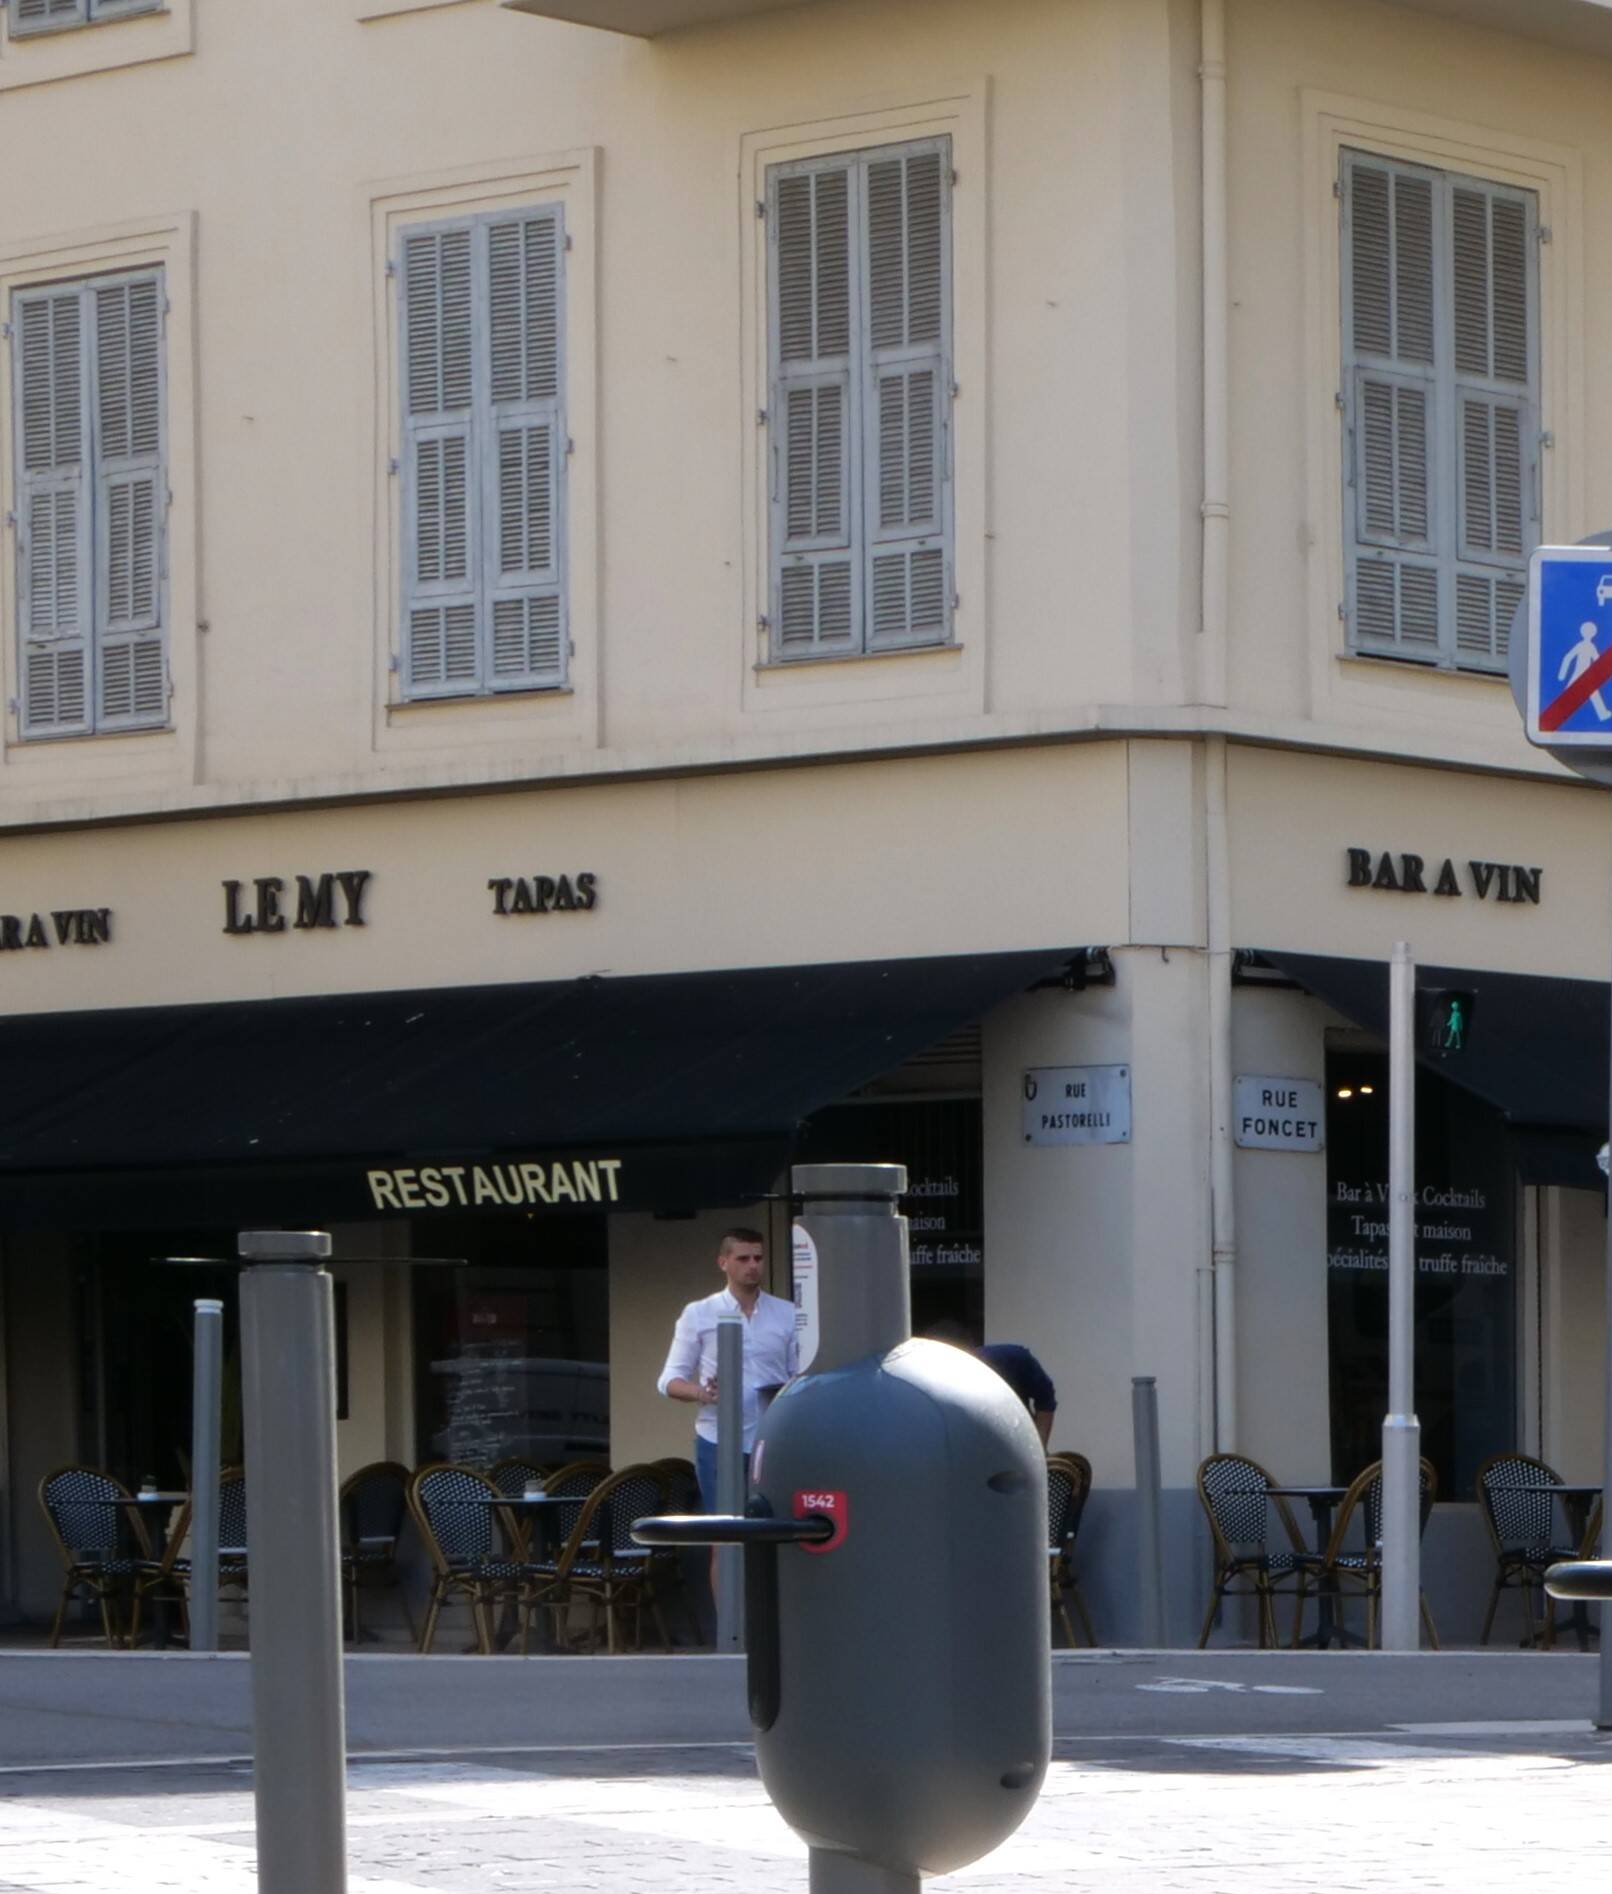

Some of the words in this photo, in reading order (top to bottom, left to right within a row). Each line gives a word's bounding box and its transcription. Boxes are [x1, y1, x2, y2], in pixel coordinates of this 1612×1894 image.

[1347, 847, 1427, 893] BAR
[1433, 857, 1462, 897] A
[1469, 860, 1543, 906] VIN
[221, 877, 286, 935] LE
[293, 870, 373, 929] MY
[487, 871, 599, 915] TAPAS
[25, 911, 49, 948] A
[50, 908, 112, 946] VIN
[1065, 1082, 1086, 1099] RUE
[1262, 1089, 1298, 1108] RUE
[1041, 1112, 1111, 1129] PASTORELLI
[1242, 1116, 1318, 1139] FONCET
[366, 1160, 622, 1210] RESTAURANT
[1336, 1181, 1361, 1201] Bar
[1423, 1185, 1486, 1208] Cocktails
[1423, 1221, 1472, 1240] maison
[1327, 1247, 1390, 1270] pécialités
[1419, 1254, 1458, 1273] truffe
[1461, 1252, 1508, 1275] fraîche
[801, 1494, 835, 1508] 1542
